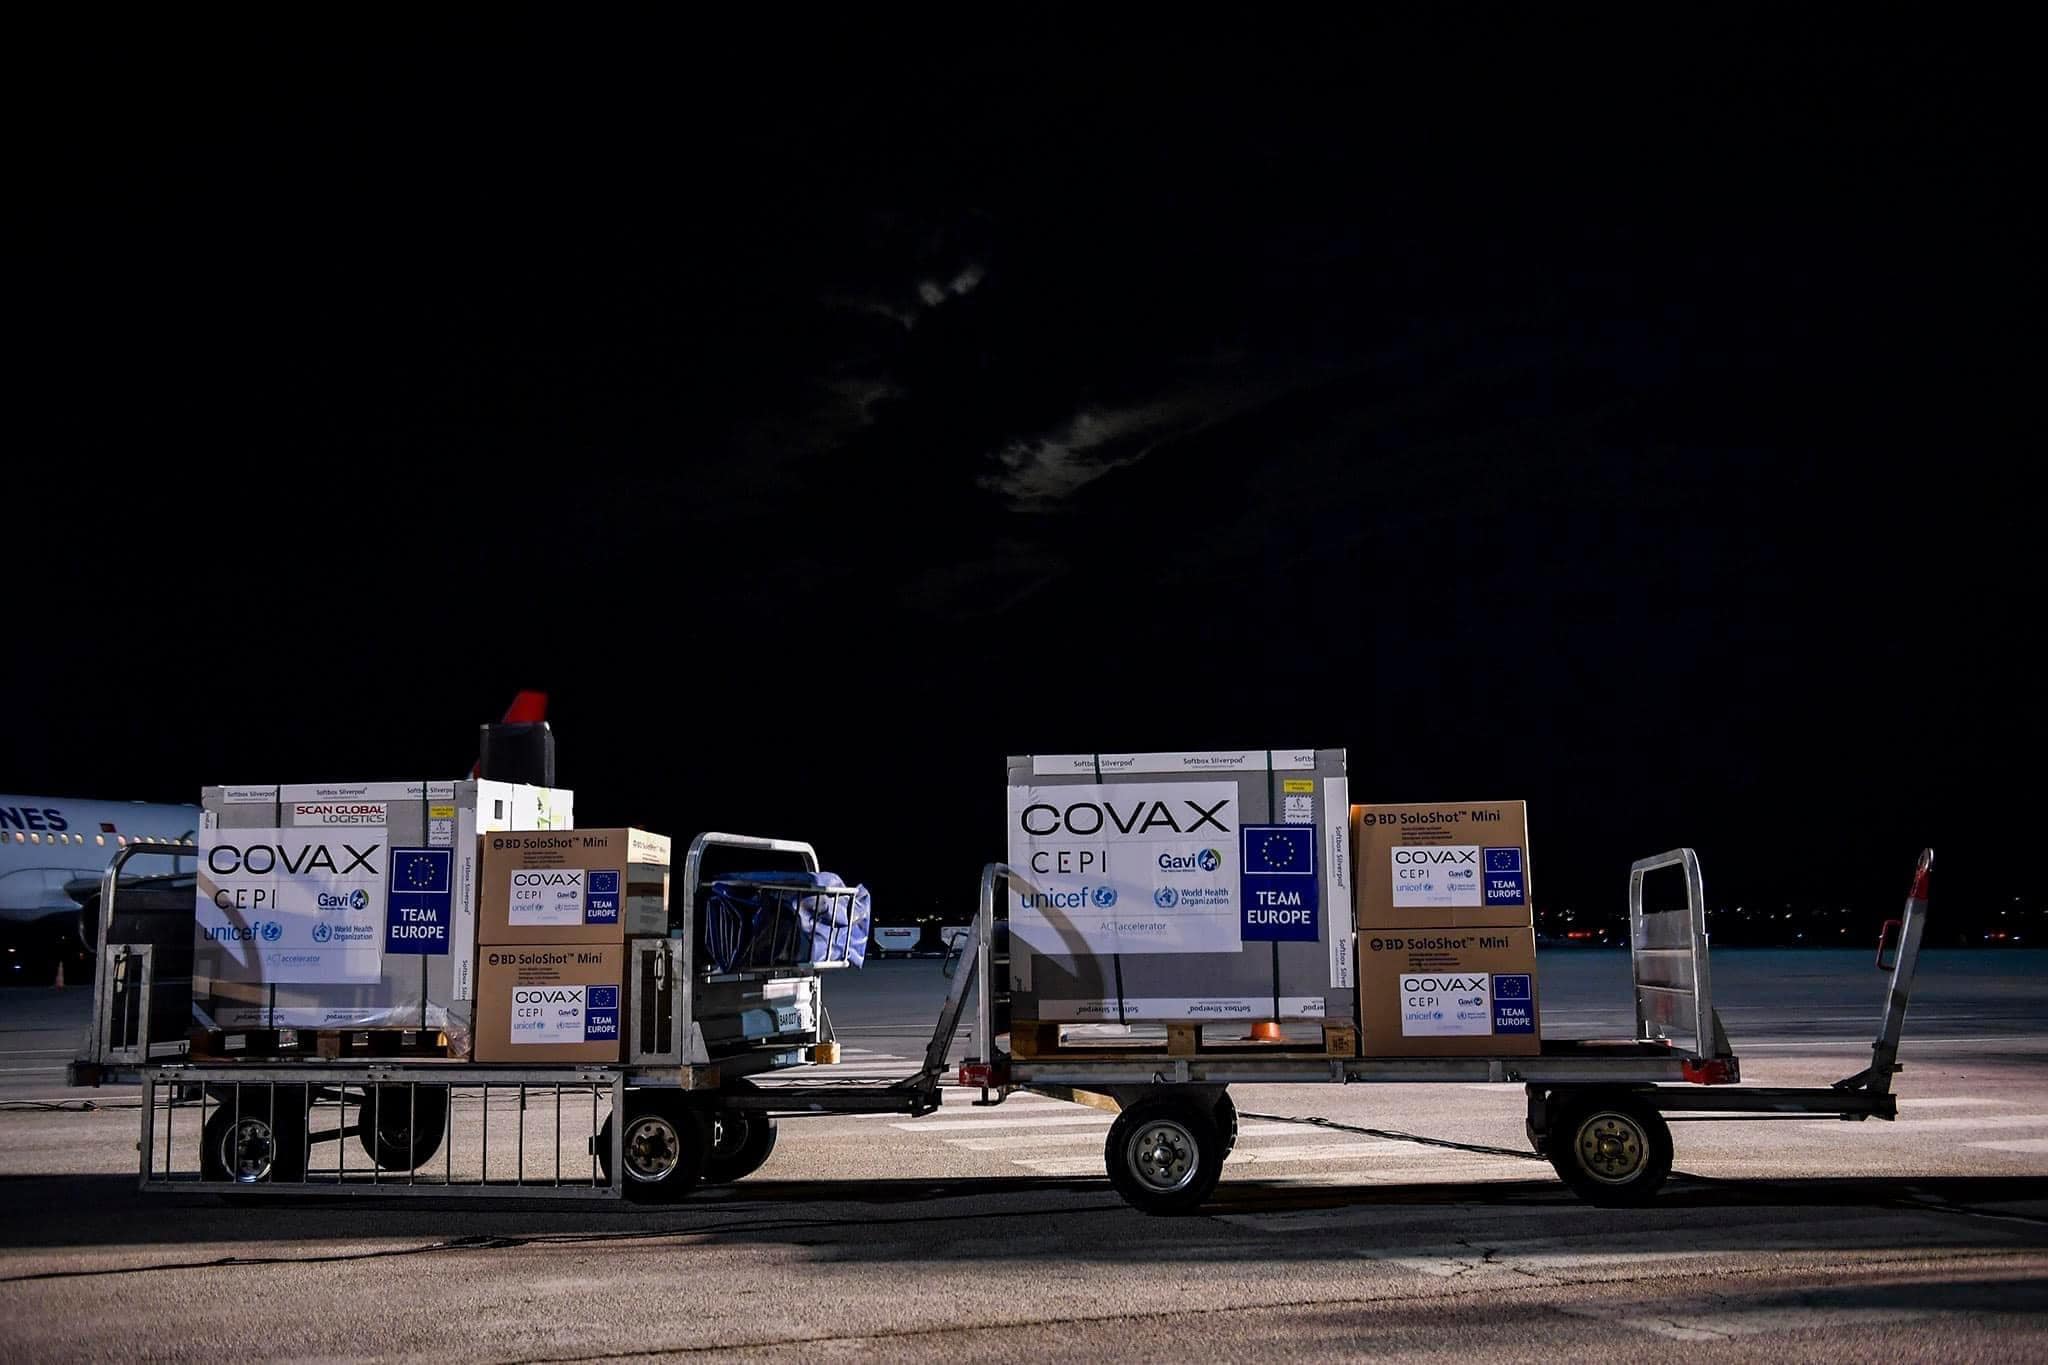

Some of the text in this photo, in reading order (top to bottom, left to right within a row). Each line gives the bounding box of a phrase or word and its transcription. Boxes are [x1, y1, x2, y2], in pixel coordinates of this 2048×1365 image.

[296, 805, 385, 815] SCAN GLOBAL
[322, 814, 384, 824] LOGISTICS
[1021, 799, 1232, 836] COVAX
[1379, 814, 1397, 825] BD
[1471, 810, 1501, 822] Mini
[505, 839, 521, 849] BD
[583, 836, 608, 848] Mini
[208, 844, 381, 875] COVAX
[1031, 850, 1107, 874] CEPI
[1158, 853, 1196, 869] Gavi
[1395, 850, 1476, 864] COVAX
[514, 873, 581, 886] COVAX
[1399, 869, 1429, 879] CEPI
[1492, 880, 1516, 889] TEAM
[516, 890, 541, 899] CEPI
[1021, 886, 1089, 909] unicef
[1181, 888, 1229, 897] World Health
[1256, 891, 1301, 906] TEAM
[1487, 890, 1521, 898] EUROPE
[214, 888, 276, 910] CEPI
[317, 892, 348, 907] Gavi
[592, 901, 612, 909] TEAM
[1181, 897, 1229, 907] Organization
[400, 908, 437, 922] TEAM
[587, 909, 616, 917] EUROPE
[1247, 909, 1311, 925] EUROPE
[203, 921, 259, 941] unicef
[334, 925, 374, 933] World Health
[391, 925, 444, 939] EUROPE
[333, 933, 373, 942] Organization
[1386, 939, 1404, 950] BD
[1480, 936, 1509, 949] Mini
[501, 954, 516, 964] BD
[577, 952, 602, 963] Mini
[1404, 978, 1486, 992] COVAX
[515, 990, 582, 1003] COVAX
[1408, 997, 1439, 1007] CEPI
[518, 1008, 543, 1017] CEPI
[1501, 1008, 1525, 1016] TEAM
[592, 1016, 612, 1025] TEAM
[1496, 1018, 1531, 1026] EUROPE
[587, 1025, 616, 1033] EUROPE
